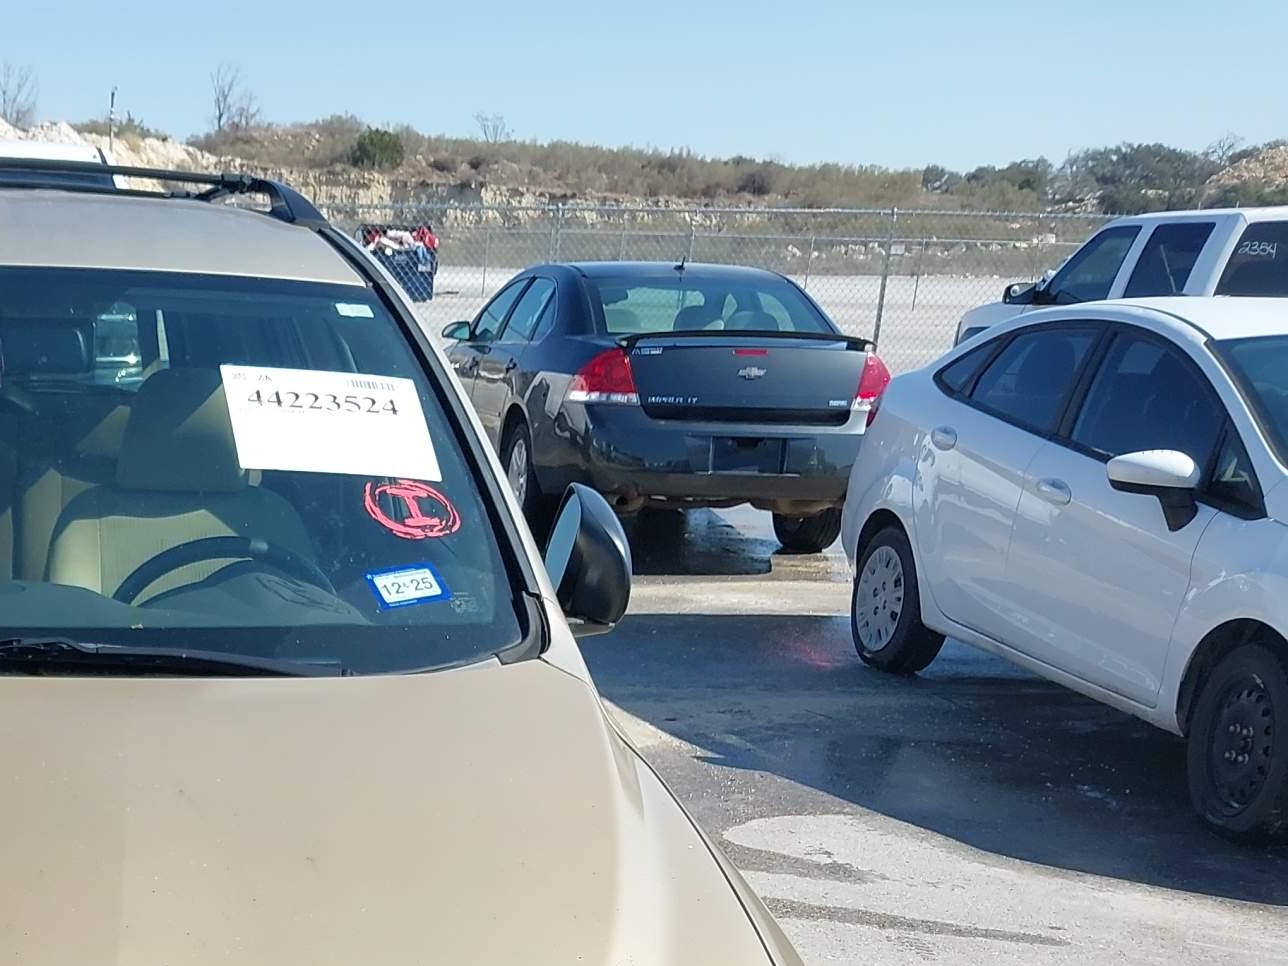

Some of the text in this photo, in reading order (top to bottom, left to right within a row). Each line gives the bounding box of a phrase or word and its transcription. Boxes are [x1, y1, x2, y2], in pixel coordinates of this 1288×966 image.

[247, 389, 400, 416] 44223524
[381, 577, 433, 596] 12 25
